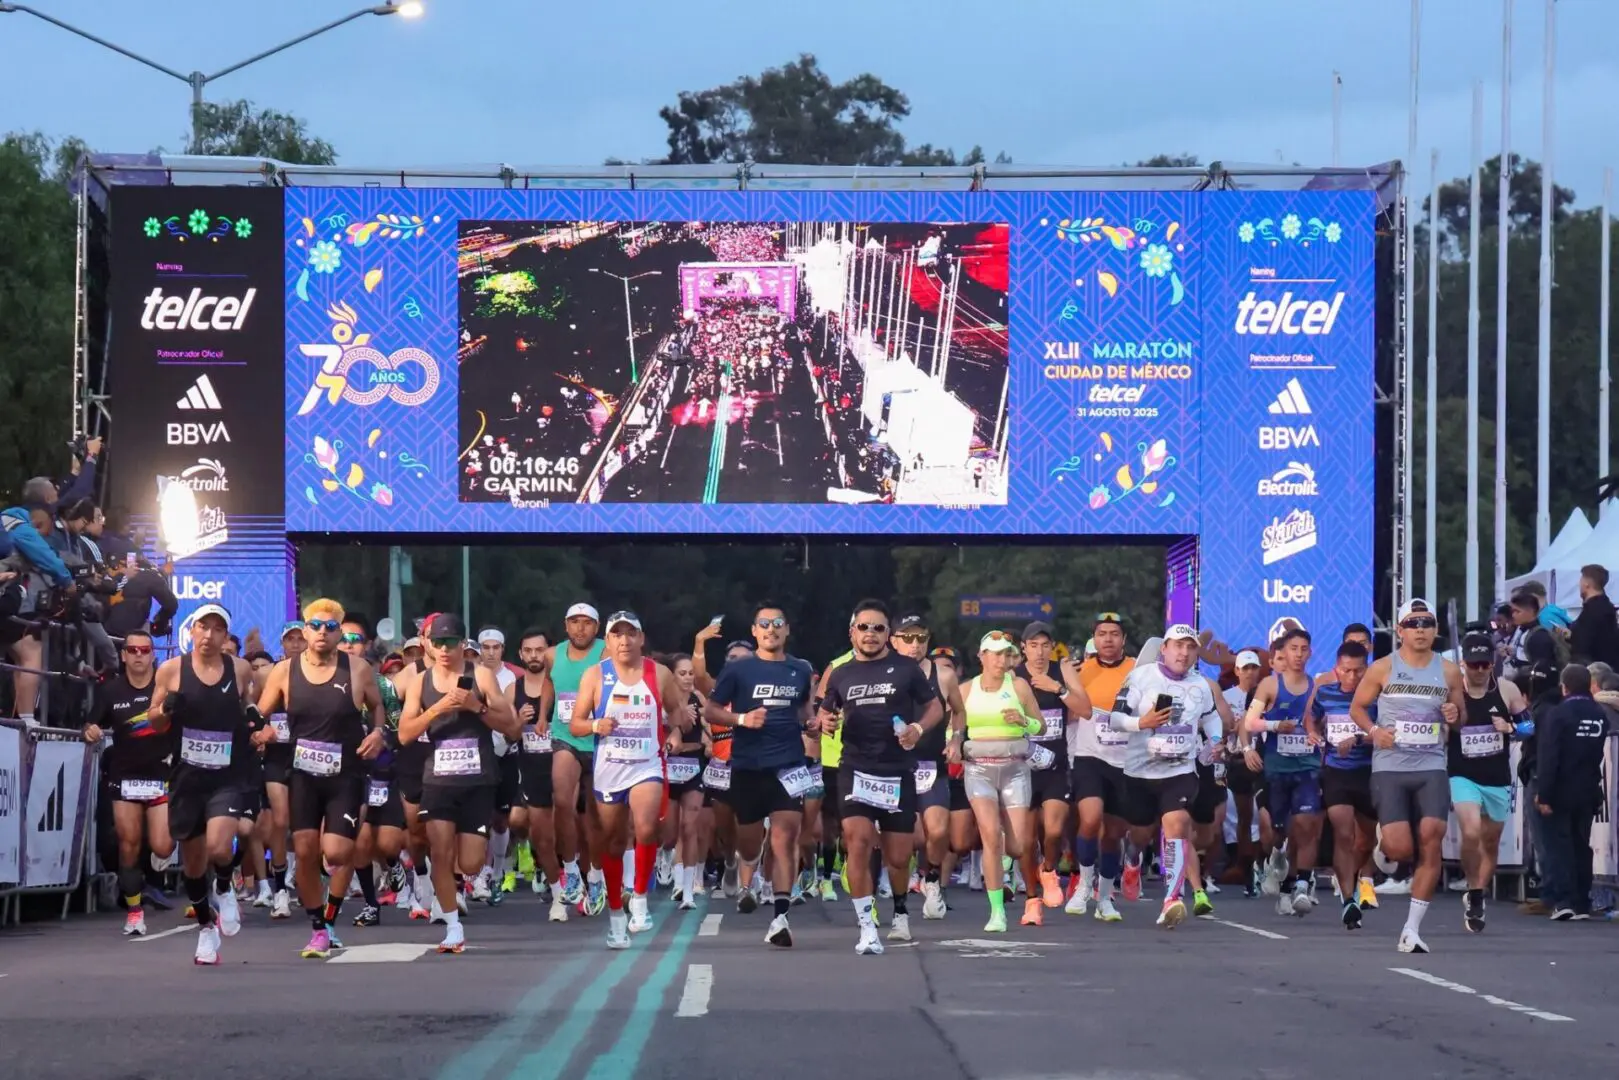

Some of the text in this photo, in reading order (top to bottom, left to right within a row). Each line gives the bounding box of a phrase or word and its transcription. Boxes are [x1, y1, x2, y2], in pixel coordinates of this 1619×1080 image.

[1250, 267, 1276, 277] Naming
[140, 287, 257, 331] telcel
[1234, 291, 1346, 335] telcel
[1043, 338, 1192, 360] XLII MARATÓN
[1250, 353, 1314, 363] Patrocinador Oficial
[369, 370, 406, 384] AÑOS
[1044, 361, 1192, 379] CIUDAD DE MÉXICO
[1088, 383, 1147, 402] telcel
[1077, 407, 1159, 417] 31 AGOSTO 2025
[167, 420, 231, 445] BBVA
[1259, 424, 1320, 449] BBVA
[512, 498, 549, 508] Varonil
[172, 575, 225, 599] Uber
[1263, 579, 1313, 603] Uber
[1403, 724, 1433, 735] 5006
[614, 738, 644, 750] 3891
[1465, 734, 1500, 745] 26464
[188, 741, 227, 755] 25471
[439, 751, 475, 763] 23224
[672, 765, 694, 774] 9995
[859, 779, 895, 796] 19648
